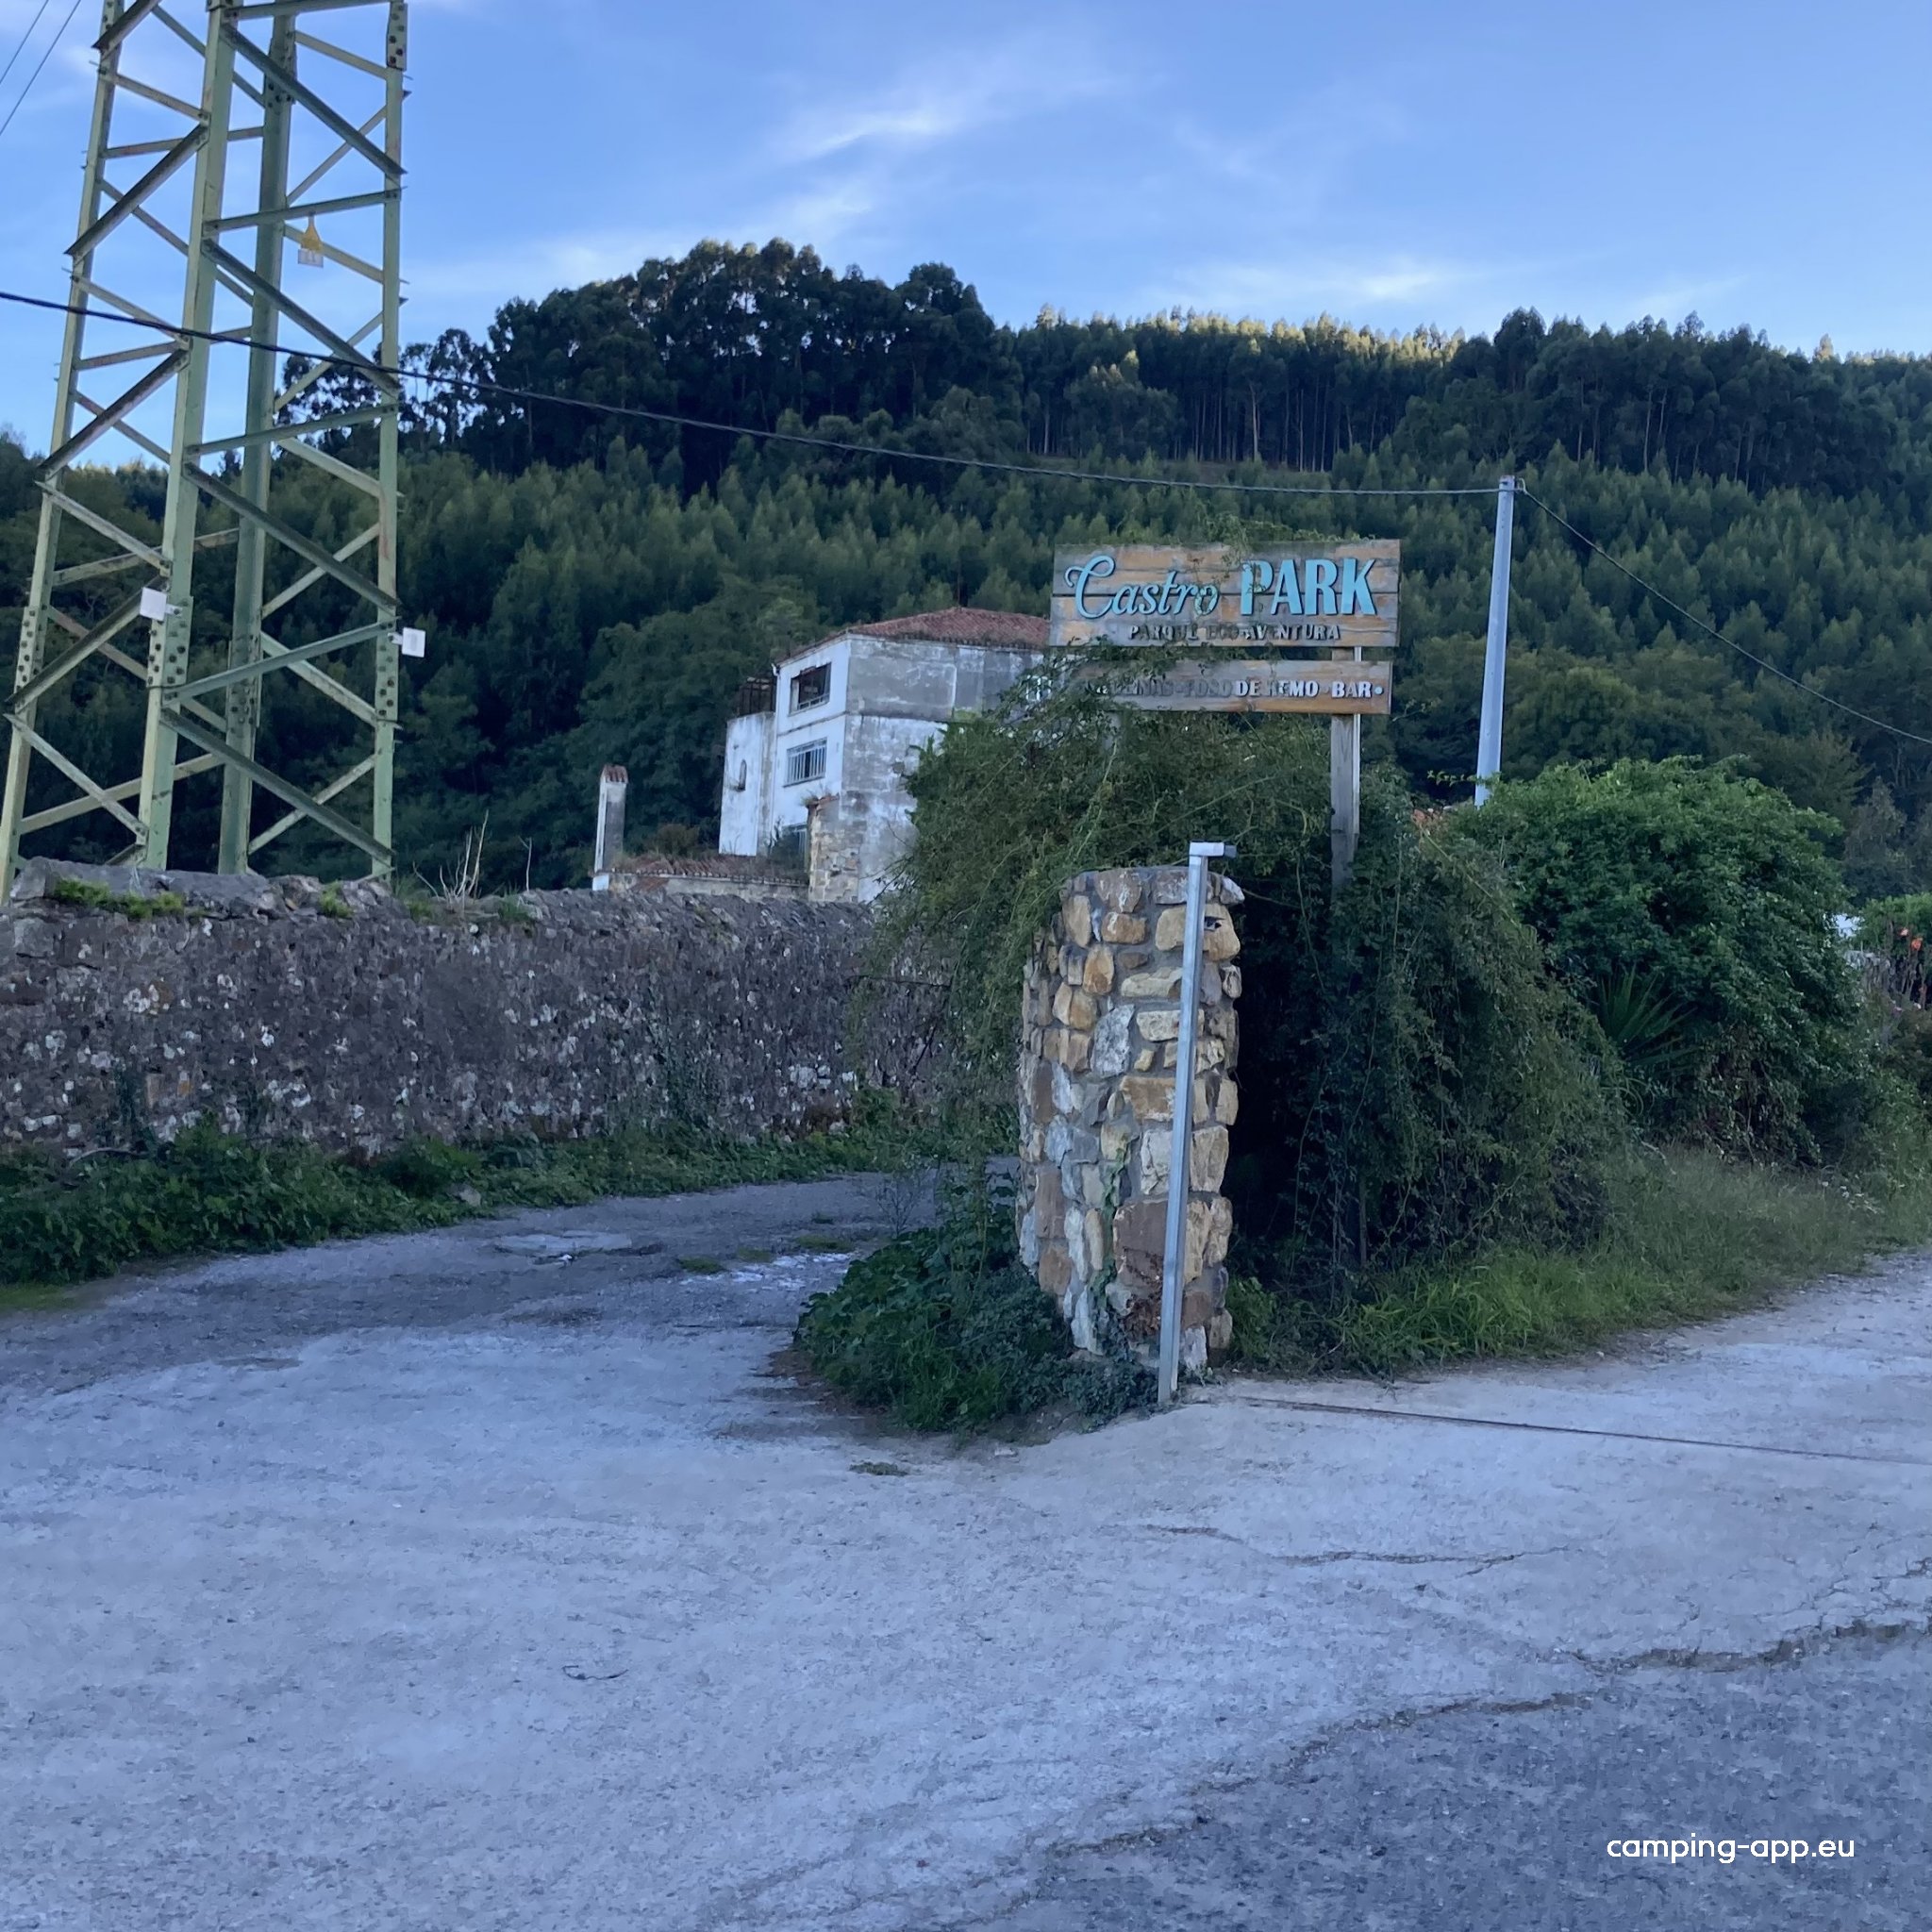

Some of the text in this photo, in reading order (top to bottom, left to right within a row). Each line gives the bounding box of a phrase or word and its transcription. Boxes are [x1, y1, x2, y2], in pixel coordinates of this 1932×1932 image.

[1064, 555, 1377, 620] Castro PARK
[1235, 679, 1260, 697] DE
[1331, 679, 1373, 698] BAR
